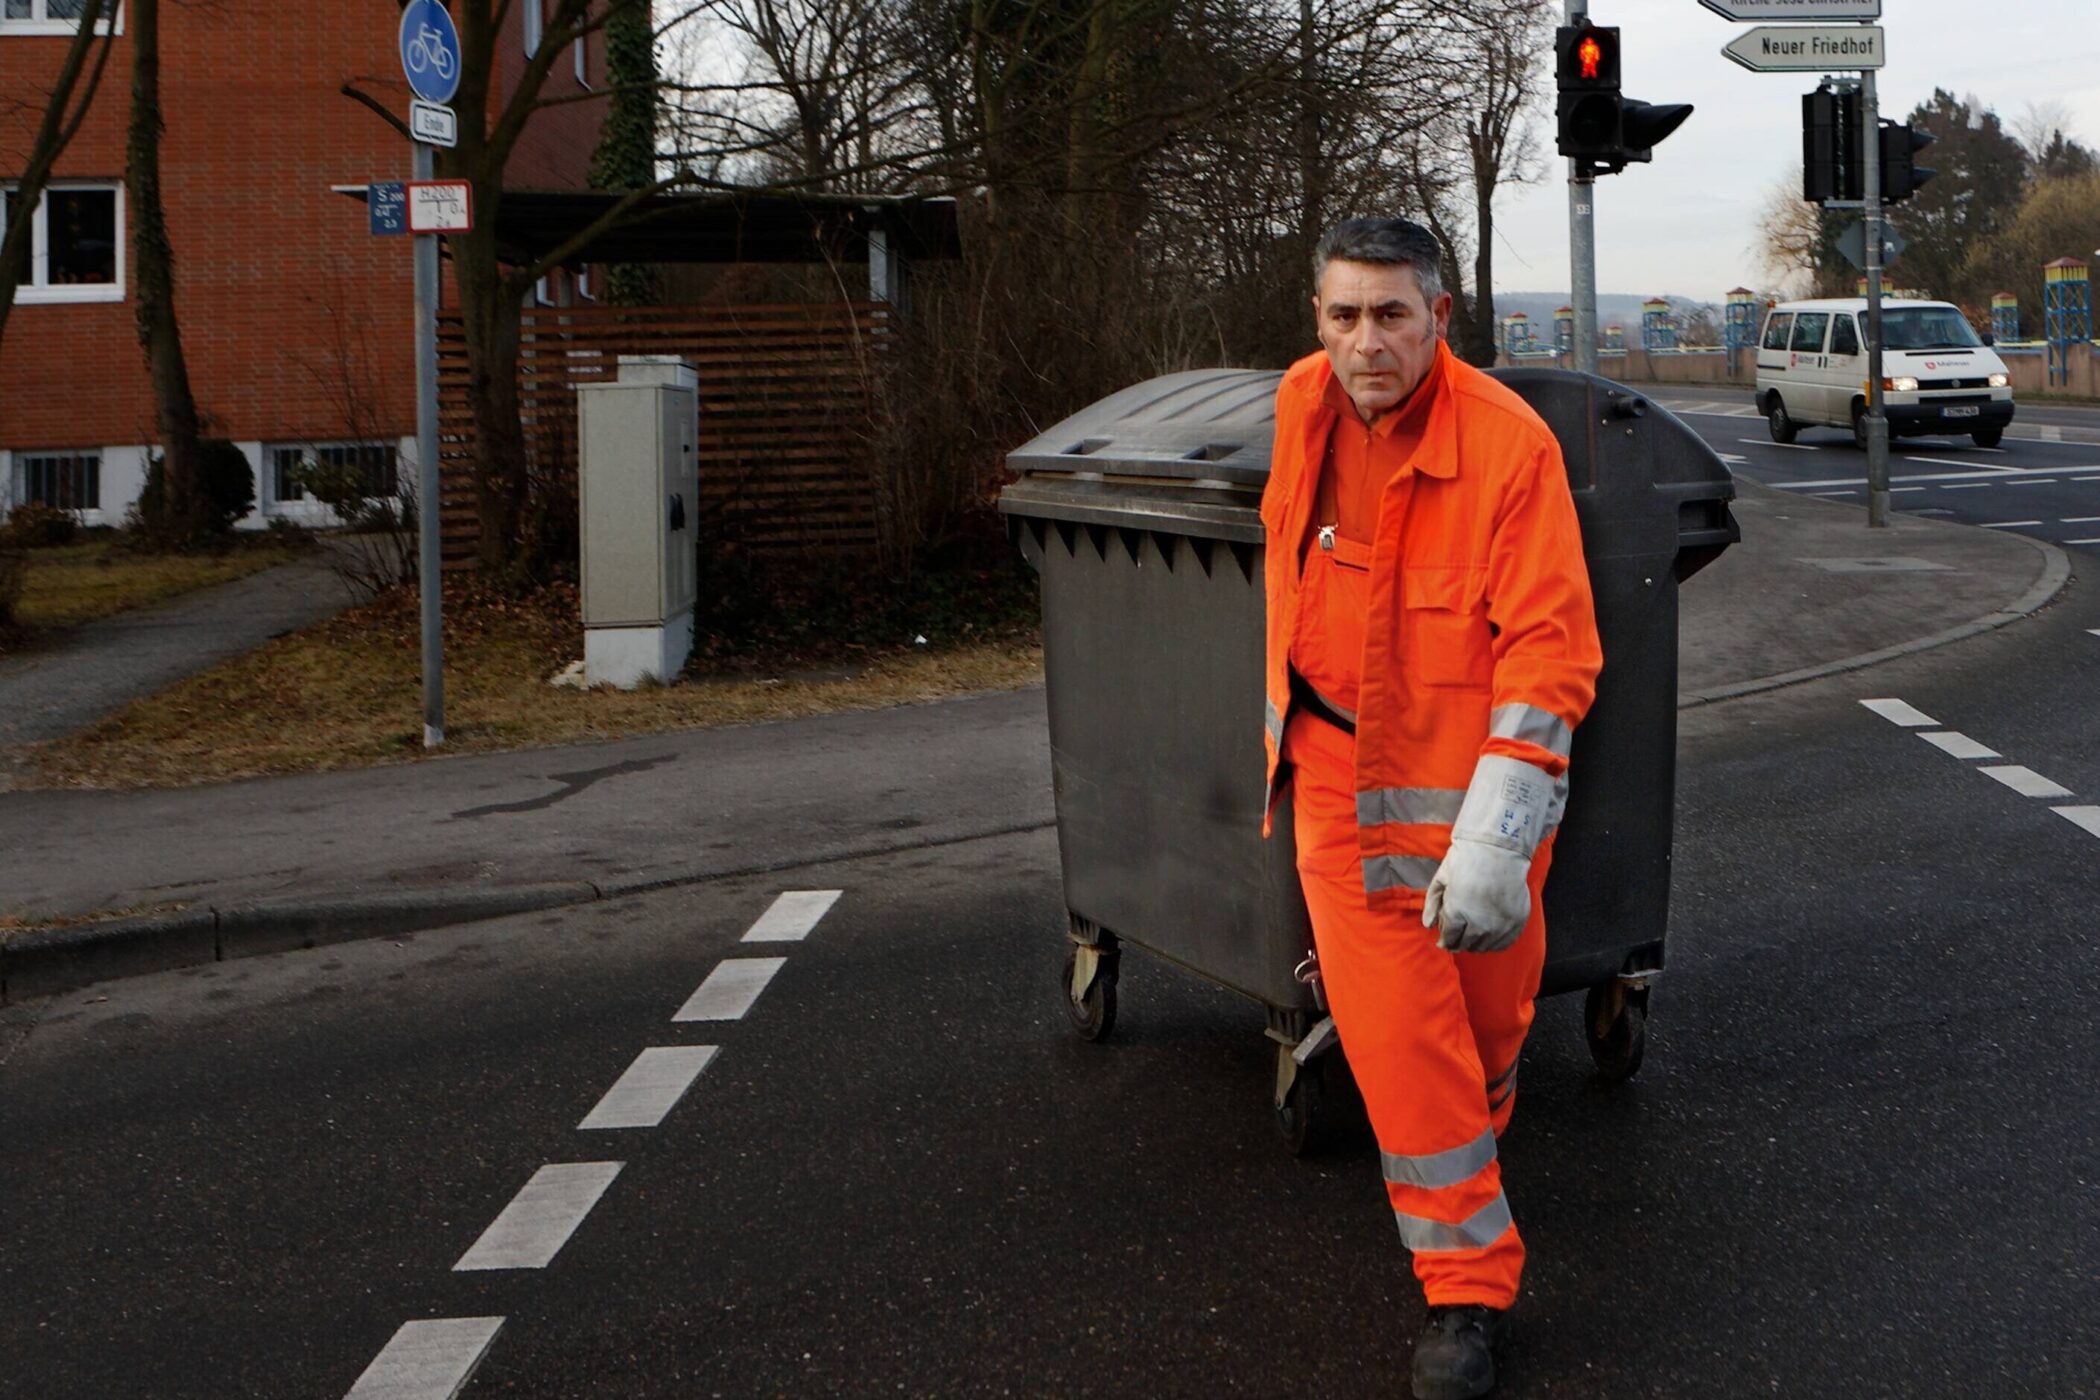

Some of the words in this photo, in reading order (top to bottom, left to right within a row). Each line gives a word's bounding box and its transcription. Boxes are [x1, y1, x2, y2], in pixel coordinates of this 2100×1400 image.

[1762, 37, 1805, 55] Neuer
[1812, 36, 1874, 55] Friedhof
[424, 113, 445, 133] Ende
